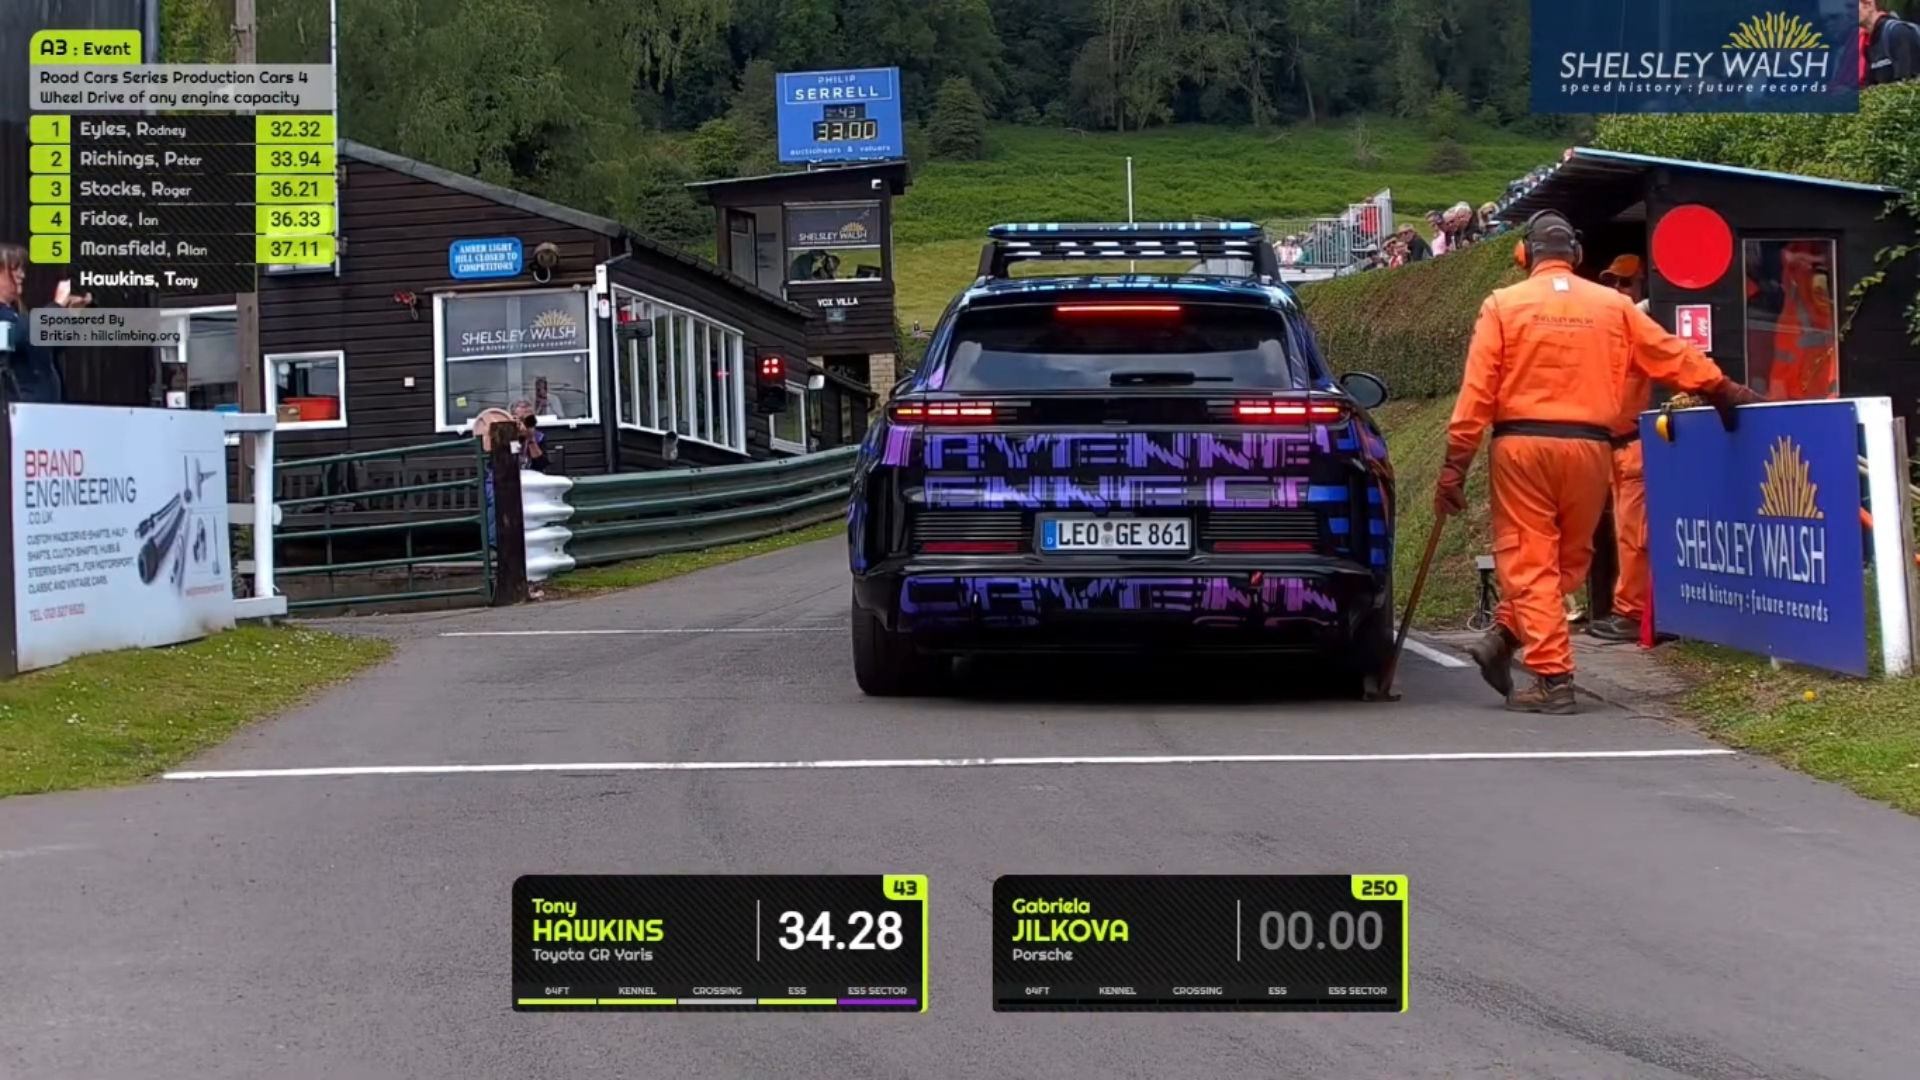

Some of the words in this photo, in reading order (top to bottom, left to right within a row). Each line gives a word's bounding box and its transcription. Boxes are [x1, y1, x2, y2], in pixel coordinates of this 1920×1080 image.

[818, 75, 856, 84] PHILIP
[795, 86, 879, 101] SERRELL
[839, 106, 856, 118] 43
[817, 121, 876, 141] 33.00
[790, 146, 841, 156] auctioneers
[860, 145, 890, 153] valuers
[460, 244, 486, 253] AMBER
[489, 243, 513, 252] LIGHT
[455, 255, 472, 263] HILL
[475, 254, 505, 263] CLOSED
[459, 263, 513, 272] COMPETITORS
[836, 298, 858, 306] VILLA
[462, 330, 526, 345] SHELSLEY
[530, 326, 576, 340] WALSH
[25, 450, 84, 478] BRAND
[25, 477, 137, 508] ENGINEERING
[1058, 522, 1099, 545] LEO
[1115, 522, 1142, 545] GE
[1148, 522, 1187, 545] 861
[1675, 517, 1756, 576] SHELSLEY
[1759, 523, 1826, 584] WALSH
[1680, 583, 1707, 604] speed
[1709, 585, 1744, 613] history
[1751, 589, 1784, 615] future
[1786, 599, 1829, 623] records
